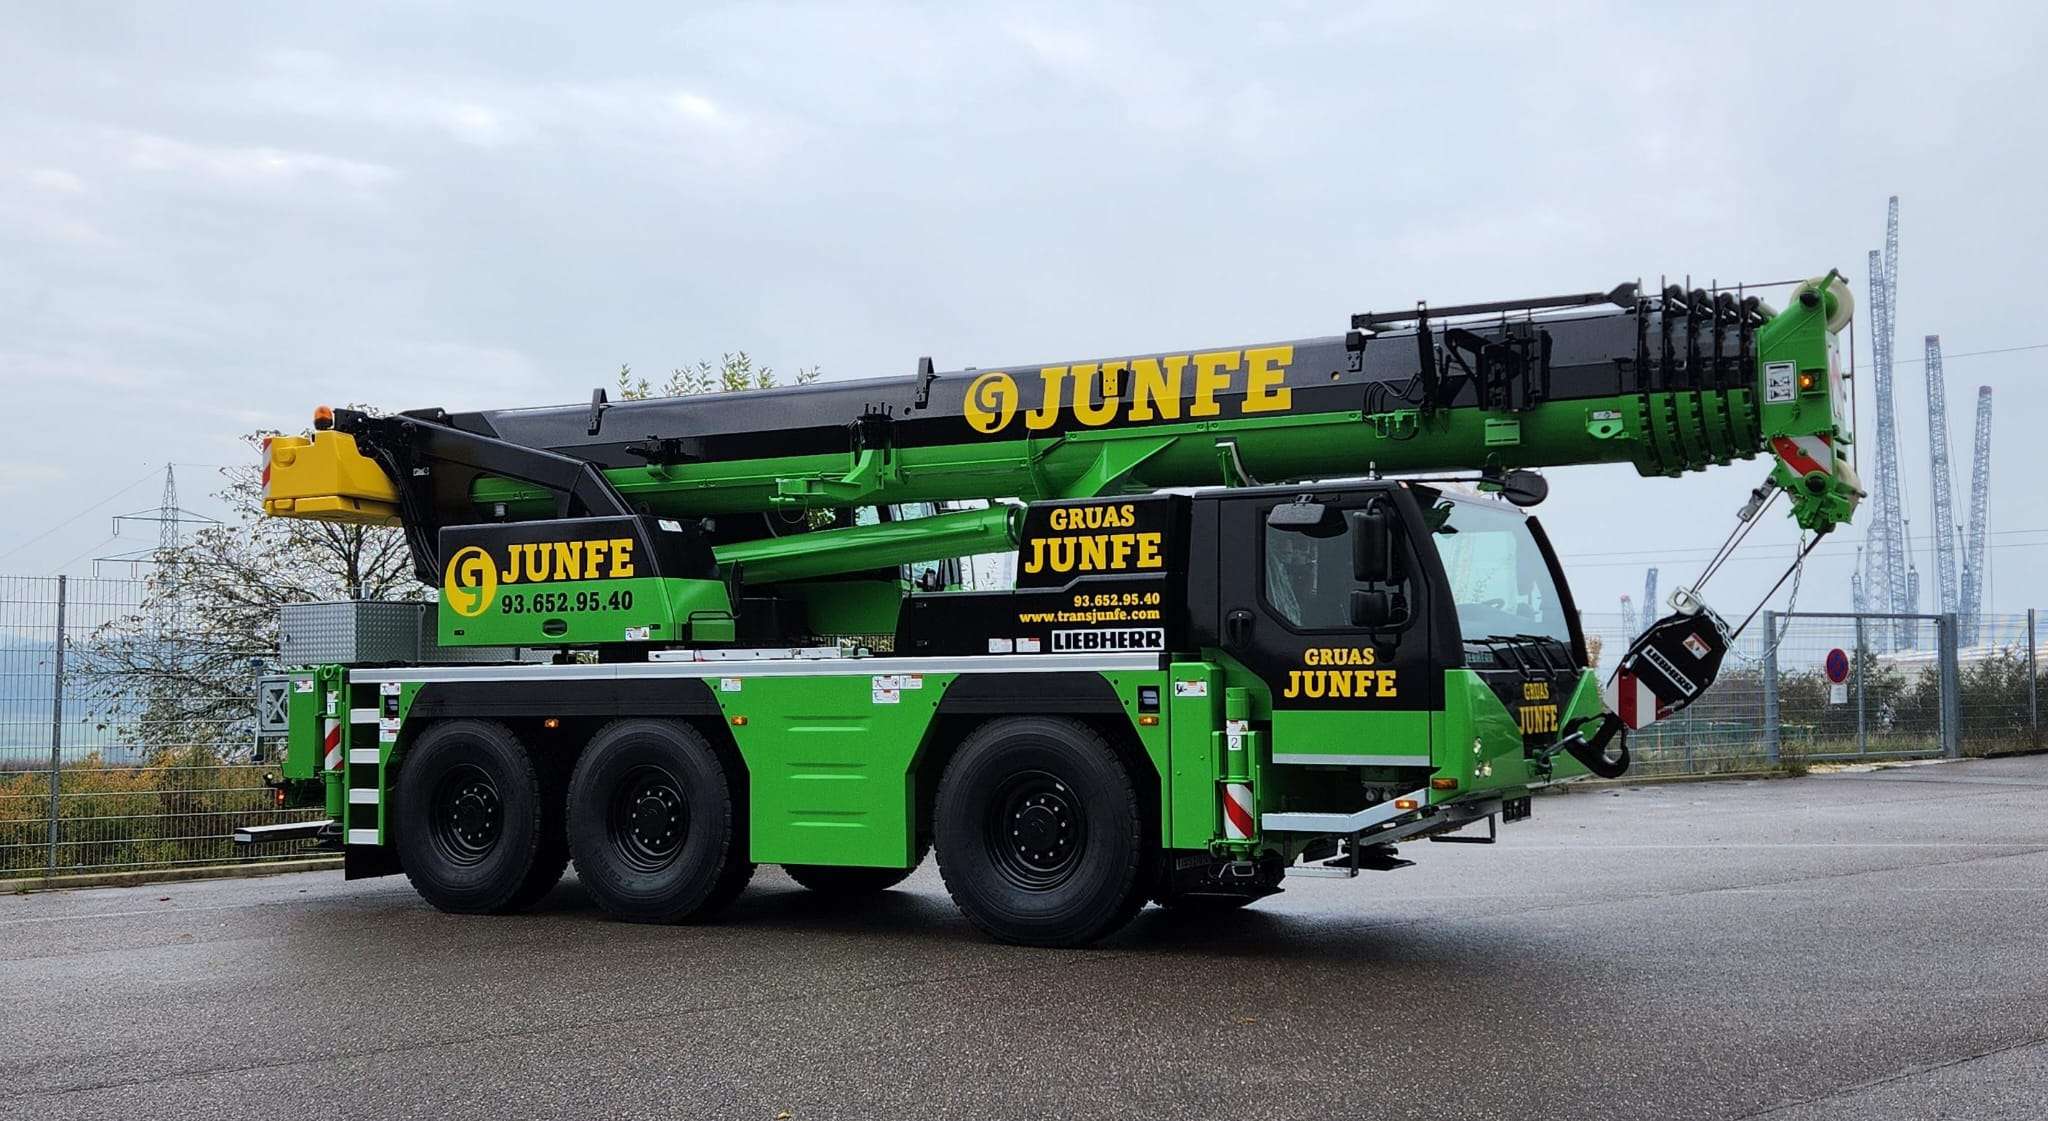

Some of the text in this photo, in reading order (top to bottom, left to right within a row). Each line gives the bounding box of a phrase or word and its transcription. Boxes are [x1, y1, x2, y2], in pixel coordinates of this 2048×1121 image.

[1025, 346, 1293, 430] JUNFE
[1050, 504, 1135, 531] GRUAS
[502, 538, 633, 583] JUNFE
[1024, 532, 1162, 573] JUNFE
[502, 590, 633, 614] 93.652.95.40
[1074, 592, 1160, 607] 93.652.95.40
[1019, 608, 1160, 624] www.transjunfe.com
[1053, 631, 1163, 650] LIEBHERR
[1304, 648, 1375, 666] GRUAS
[1283, 670, 1397, 698] JUNFE
[1644, 648, 1694, 694] LIEBHERR
[1519, 705, 1558, 735] JUNFE
[1231, 737, 1238, 749] 2
